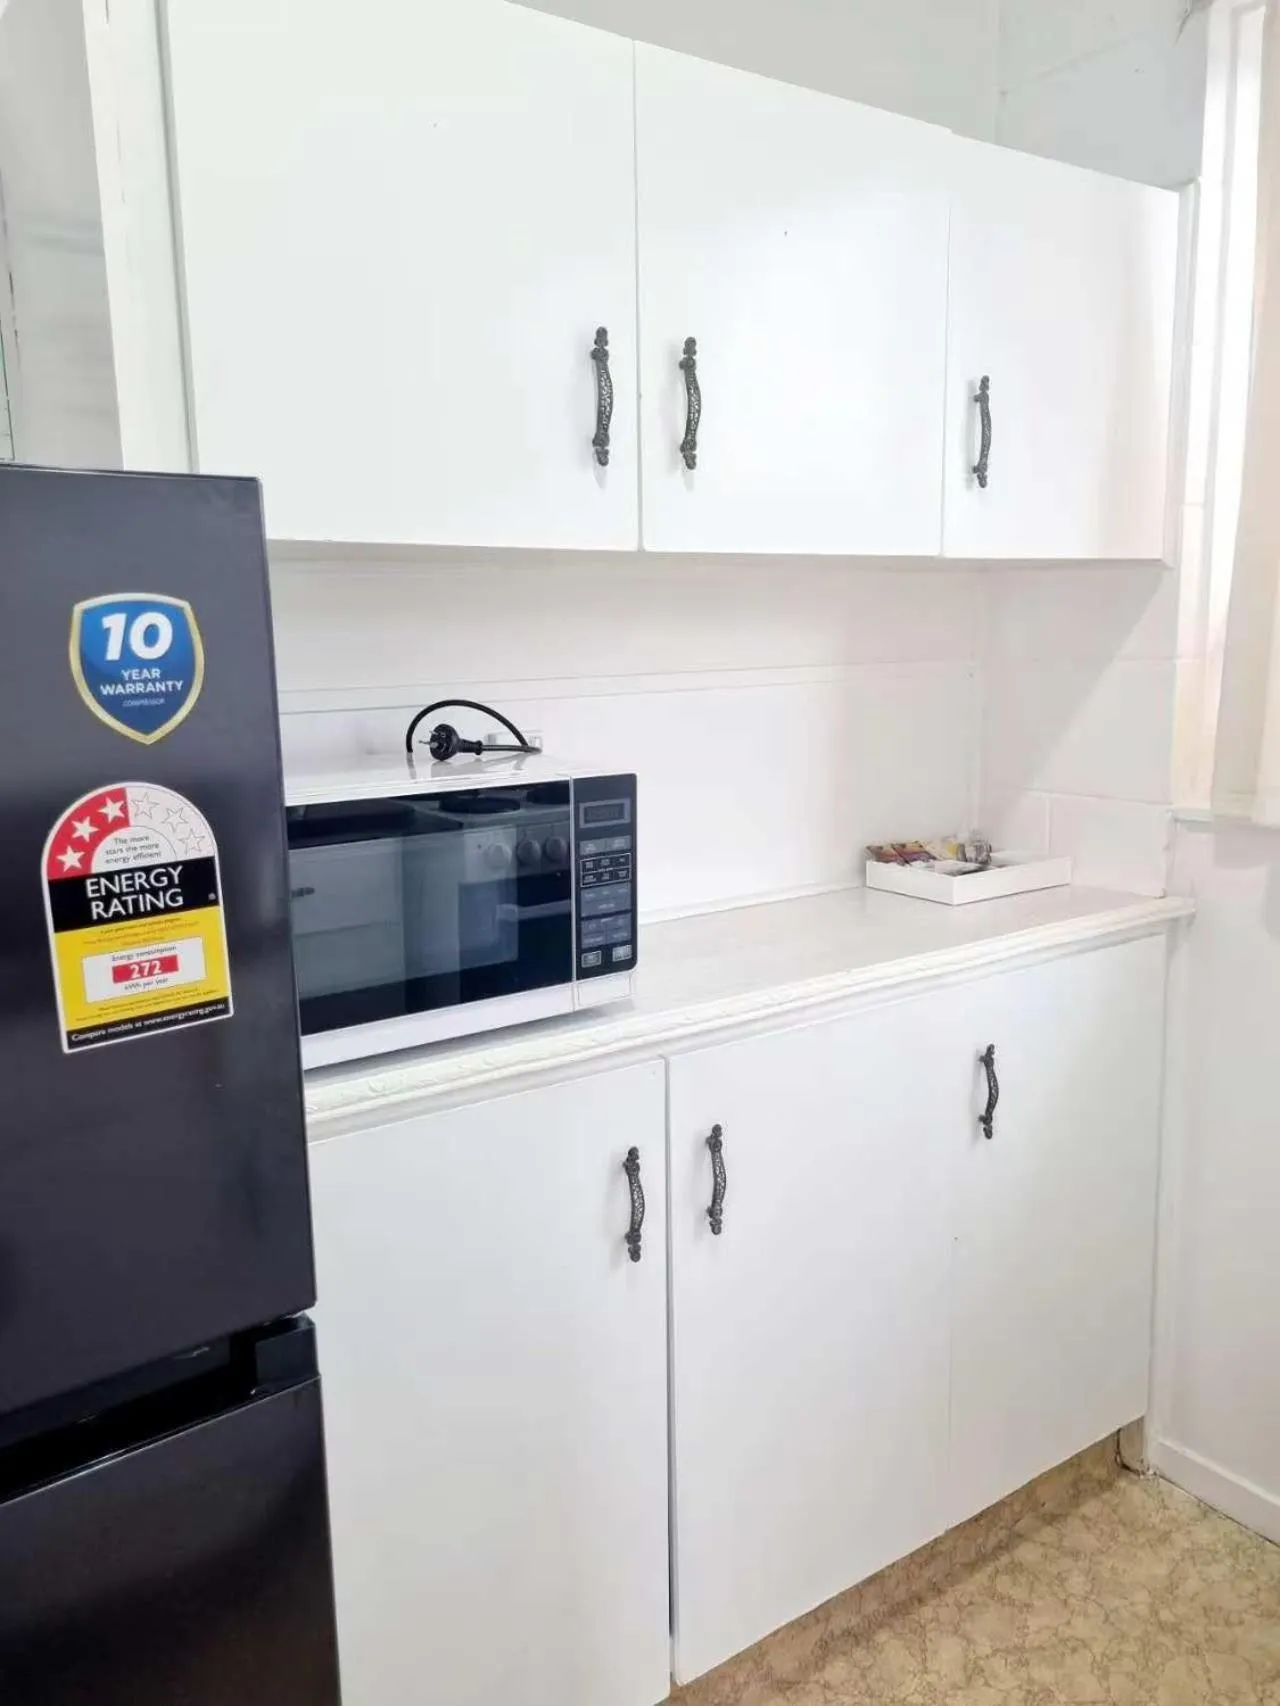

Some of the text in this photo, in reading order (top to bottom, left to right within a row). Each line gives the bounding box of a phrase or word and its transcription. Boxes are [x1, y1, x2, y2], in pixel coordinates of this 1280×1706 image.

[102, 612, 173, 661] 10
[121, 668, 161, 680] YEAR
[100, 680, 183, 696] WARRANTY
[114, 837, 127, 845] The
[139, 842, 160, 850] more
[104, 851, 161, 865] energy efficient
[85, 865, 184, 899] ENERGY
[91, 888, 184, 920] RATING
[111, 953, 134, 962] Energy
[130, 960, 162, 979] 272
[71, 1027, 107, 1042] Compare
[107, 1022, 134, 1034] models
